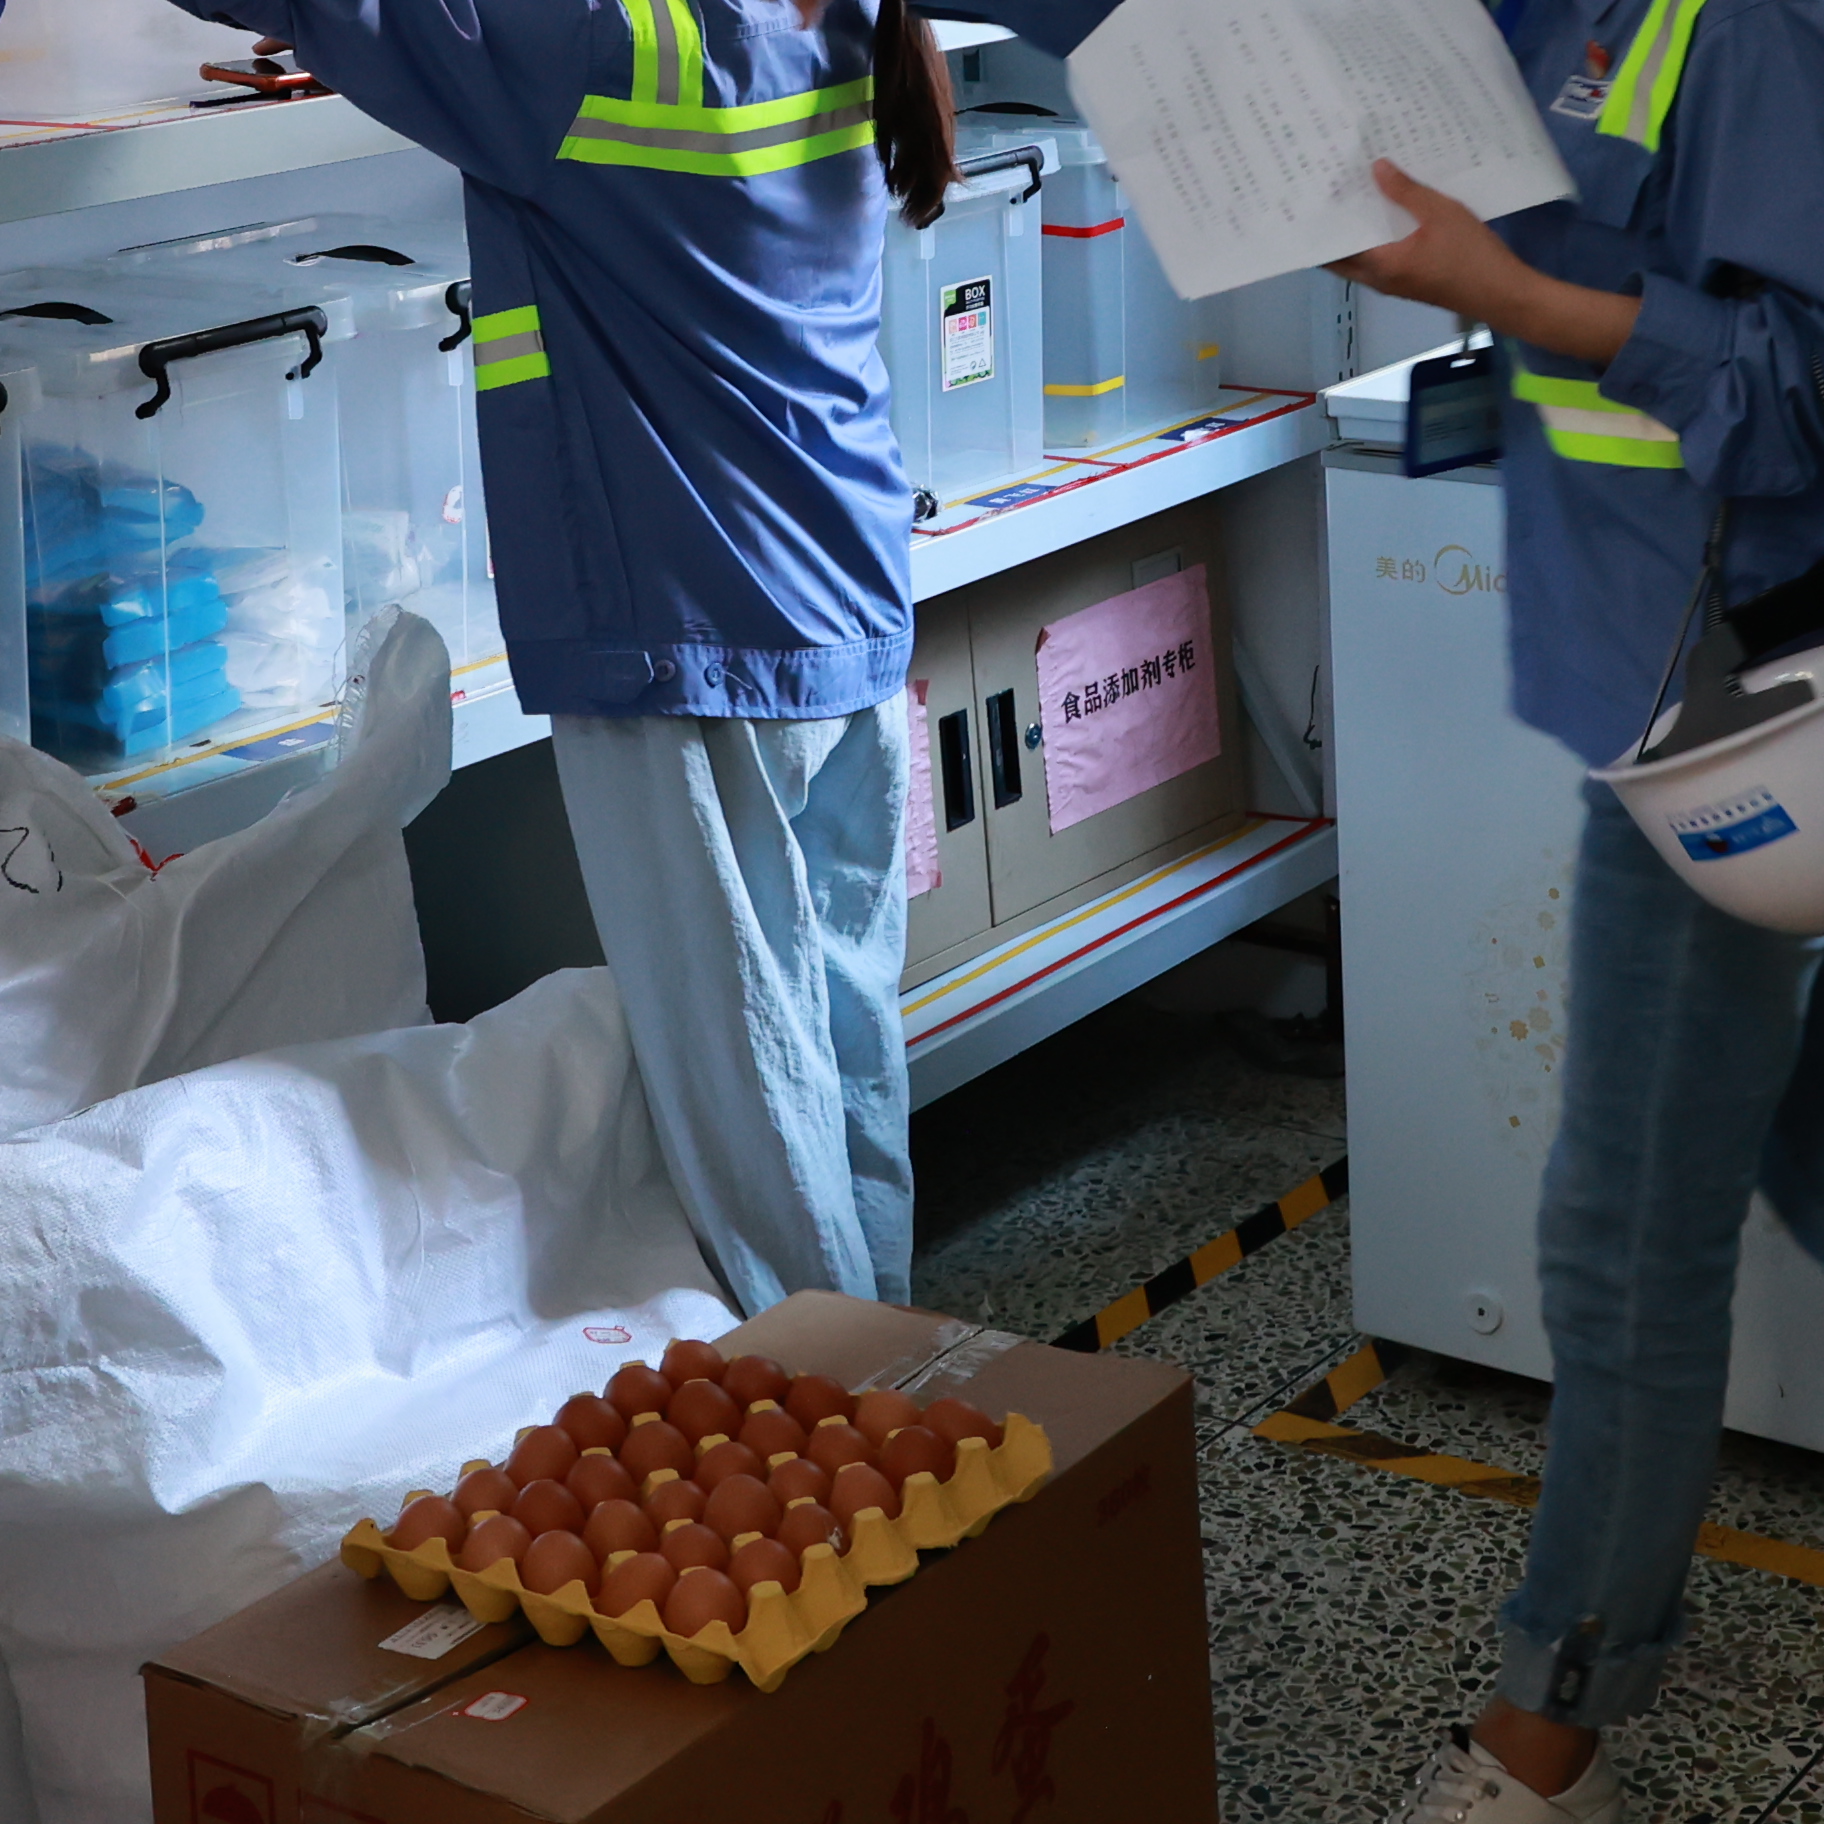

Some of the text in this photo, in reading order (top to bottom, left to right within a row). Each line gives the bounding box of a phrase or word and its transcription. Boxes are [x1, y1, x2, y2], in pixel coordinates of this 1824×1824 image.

[965, 285, 986, 300] BOX
[1376, 556, 1426, 583] 美的
[1060, 639, 1197, 725] 食品添加剂专柜
